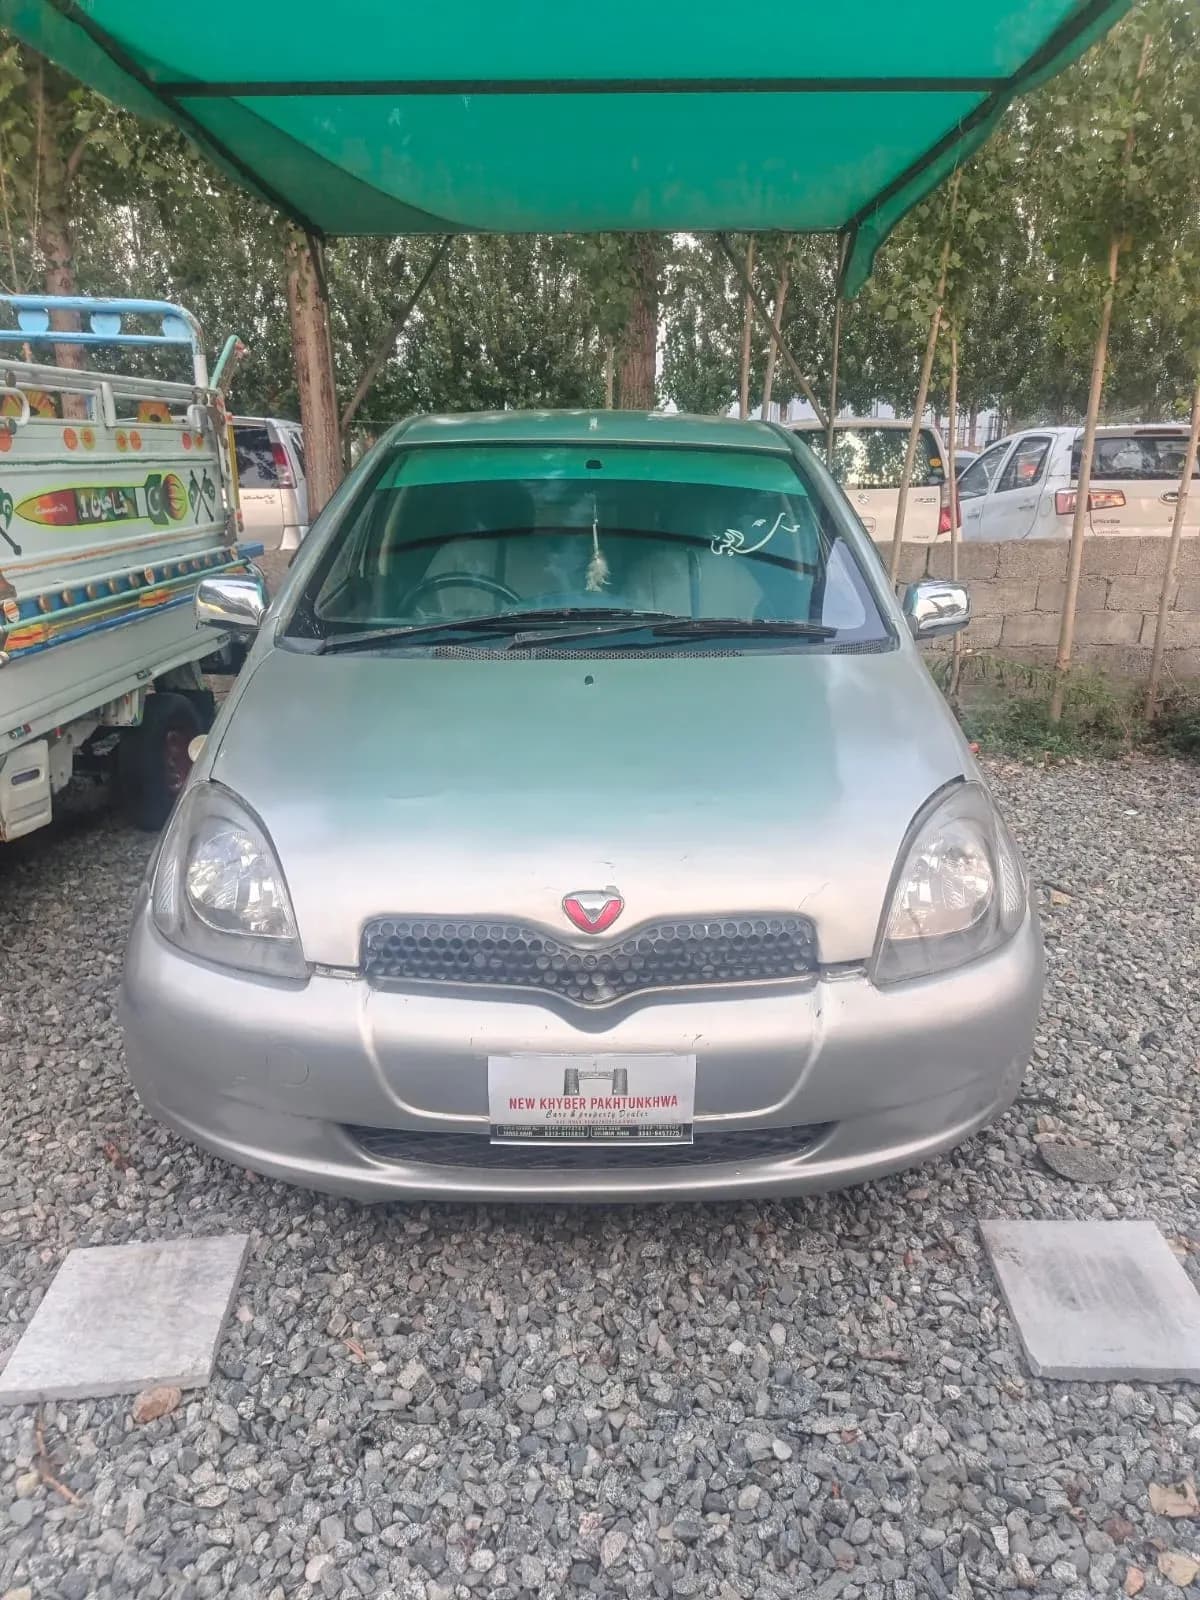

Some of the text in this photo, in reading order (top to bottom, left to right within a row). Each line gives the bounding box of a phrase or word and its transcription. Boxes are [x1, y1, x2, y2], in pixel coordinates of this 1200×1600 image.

[509, 1095, 679, 1110] NEW KHYBER PAKHTUNKHWA
